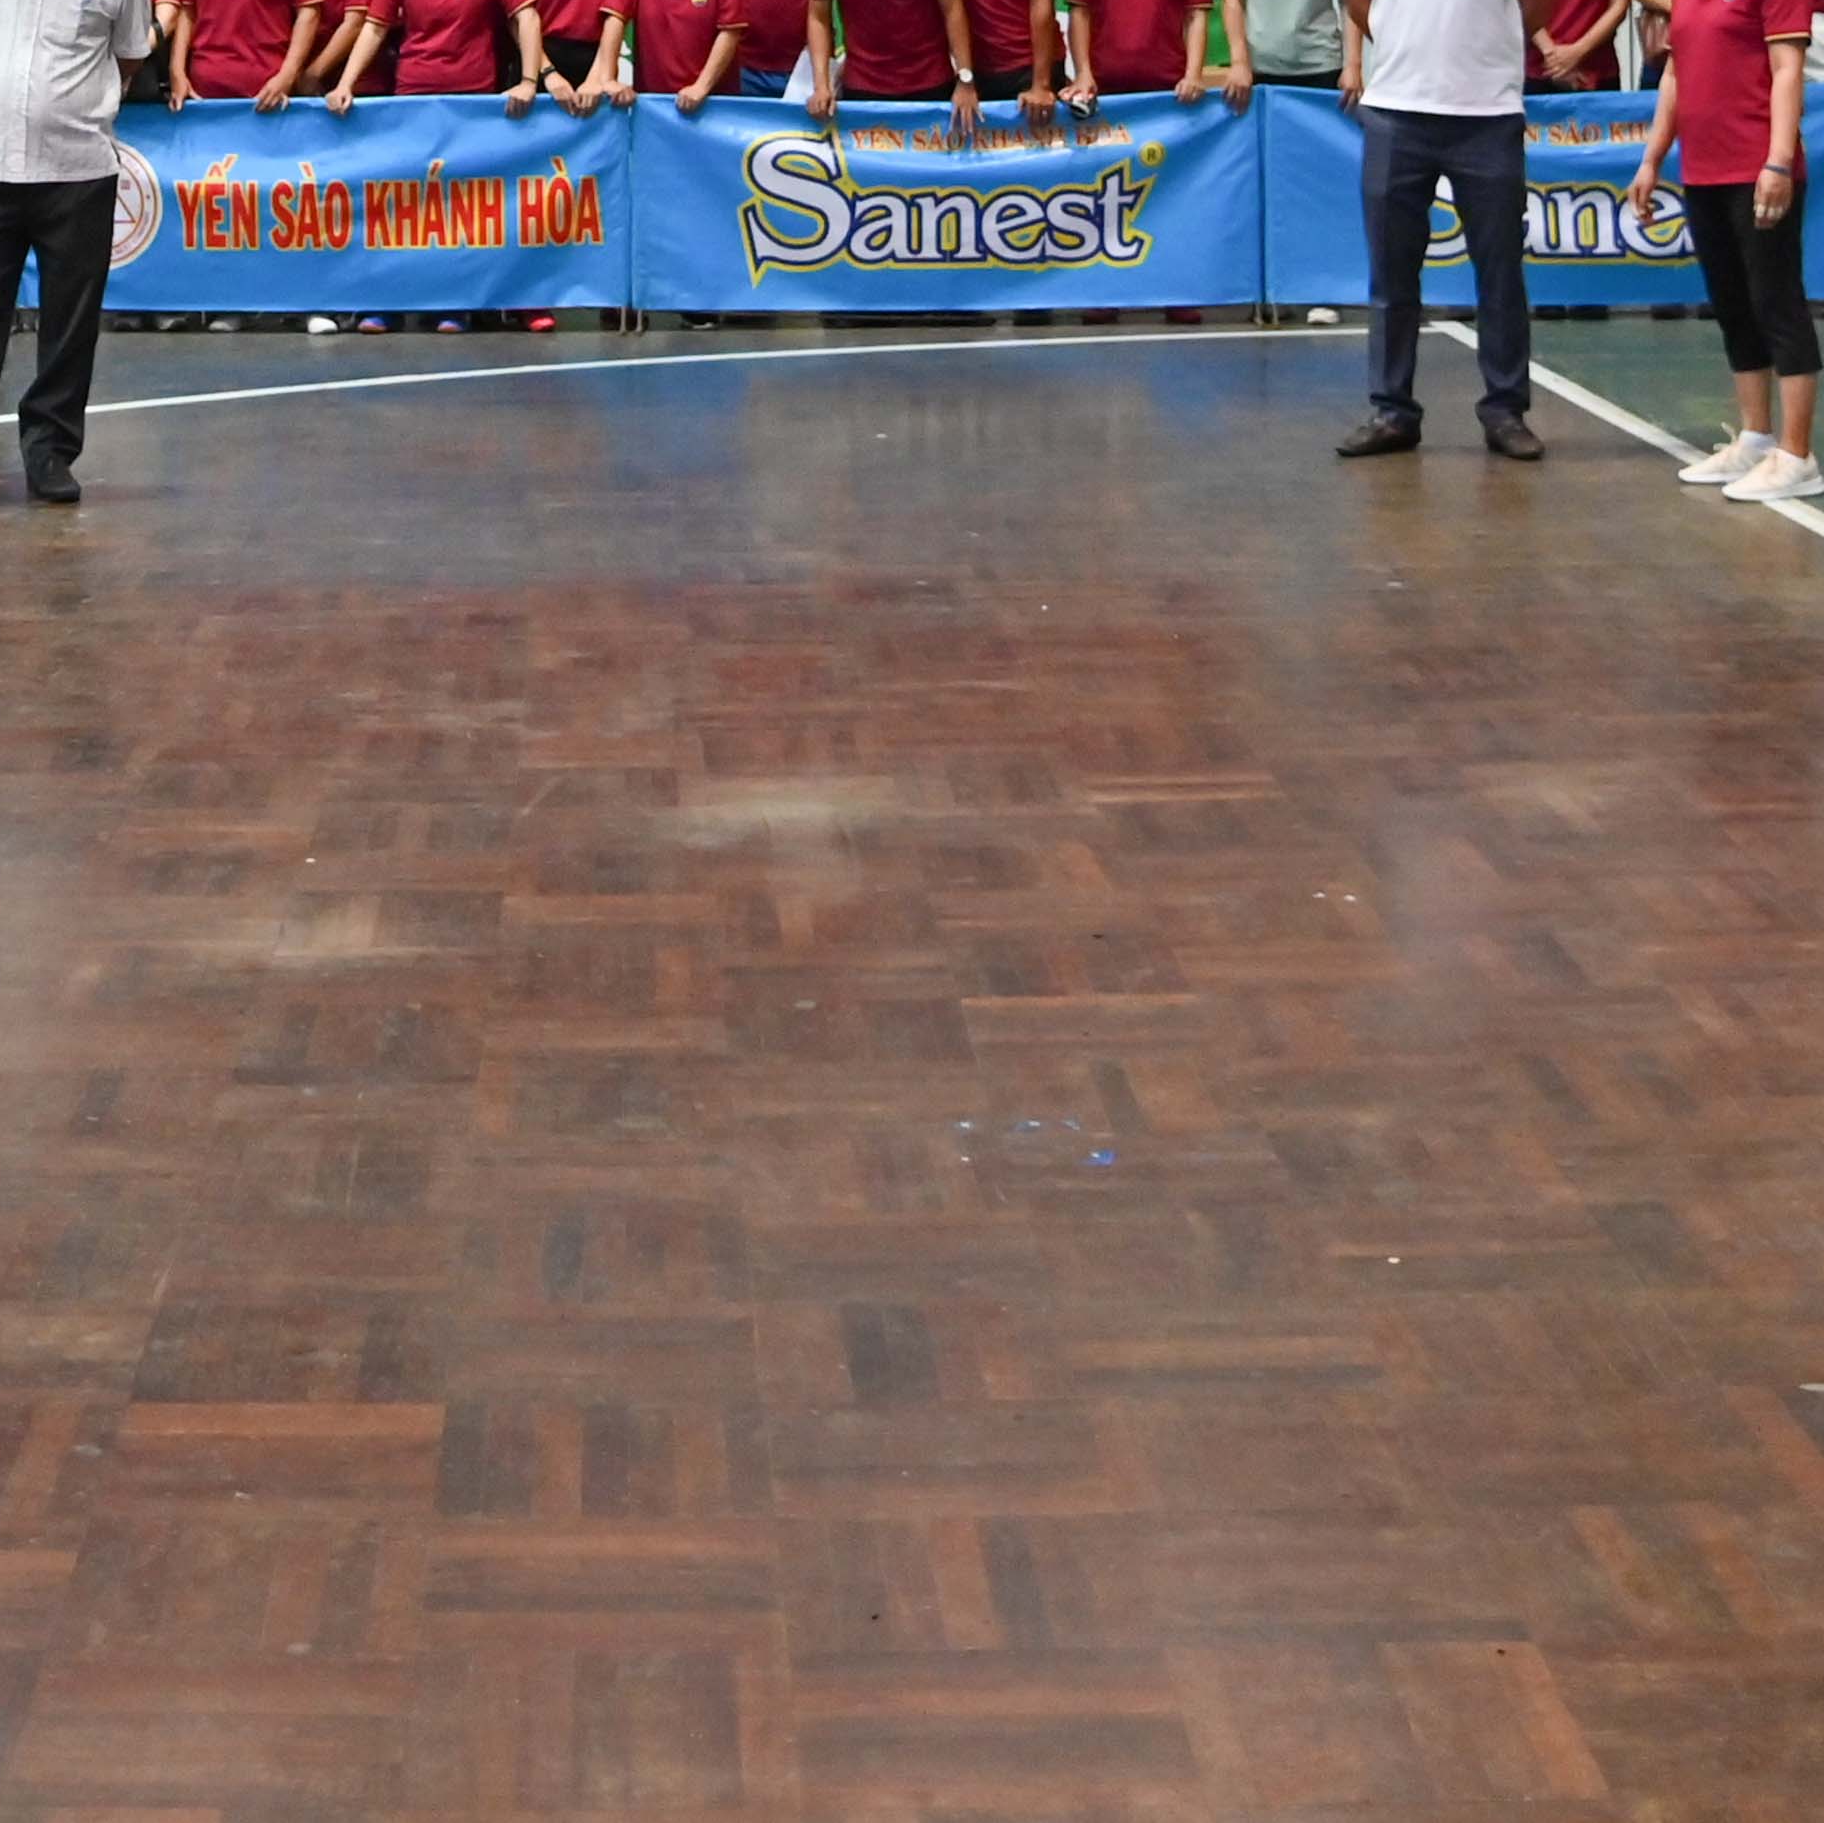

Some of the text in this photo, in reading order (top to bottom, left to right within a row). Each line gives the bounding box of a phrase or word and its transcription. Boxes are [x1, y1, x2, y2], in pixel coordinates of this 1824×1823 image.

[175, 154, 260, 250] YẾN
[270, 161, 352, 250] SÀO
[365, 159, 503, 248] KHÁNH
[518, 155, 604, 246] HÒA
[743, 132, 1148, 270] Sanest
